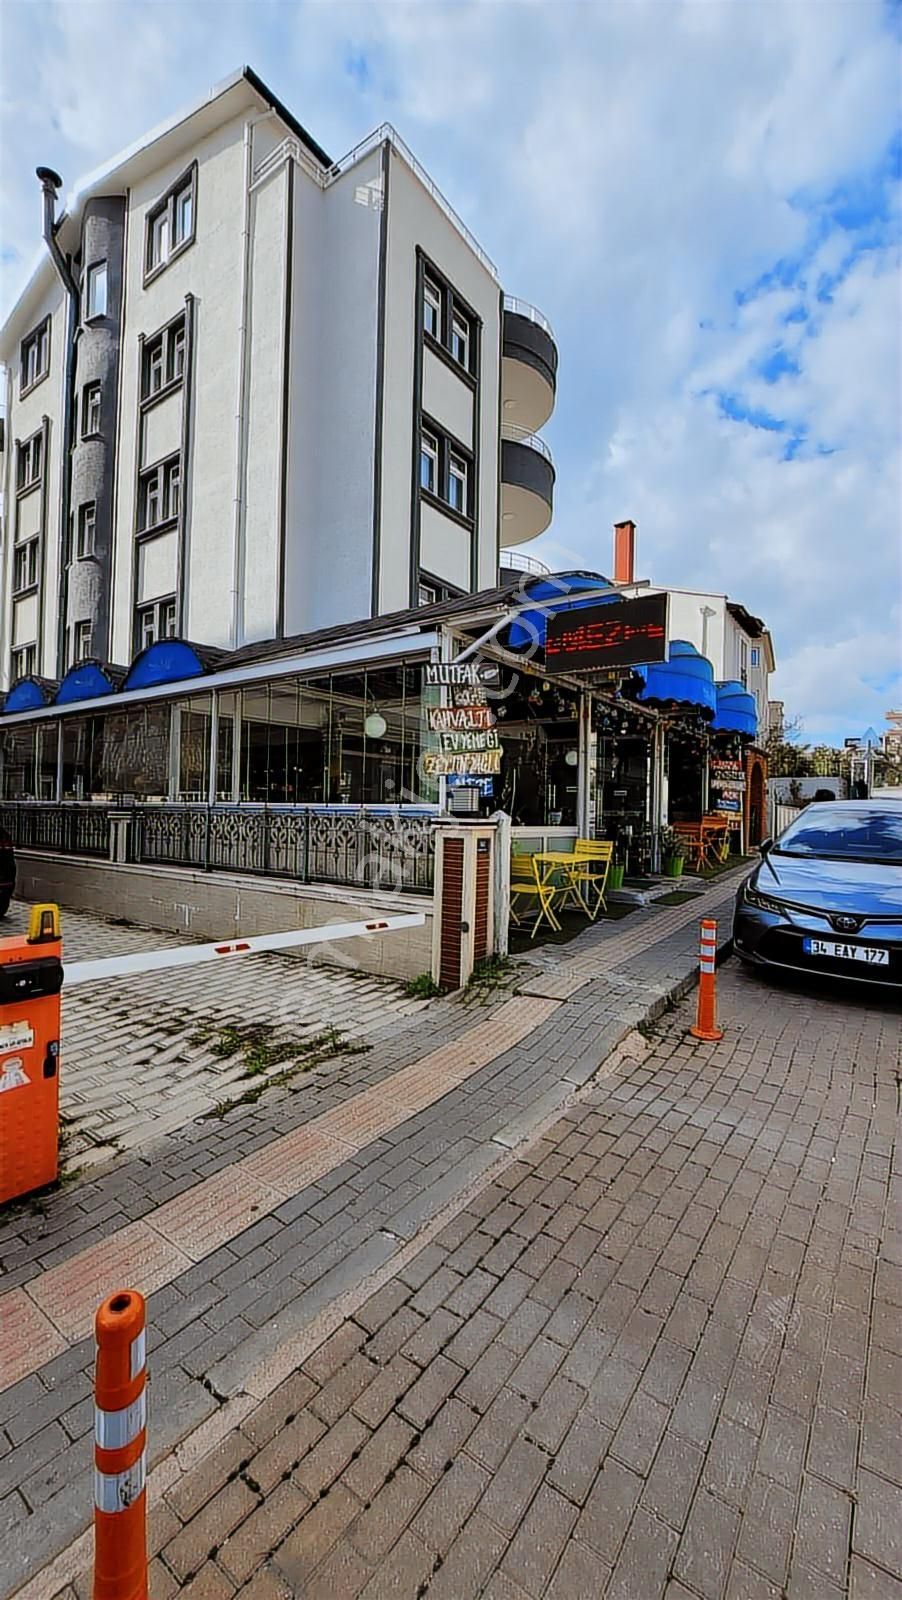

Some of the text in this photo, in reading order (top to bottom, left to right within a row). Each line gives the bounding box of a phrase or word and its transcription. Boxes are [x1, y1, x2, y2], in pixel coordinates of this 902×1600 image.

[426, 664, 481, 684] MUTFAK
[442, 733, 459, 750] EV
[812, 941, 886, 963] 34 EAY 177
